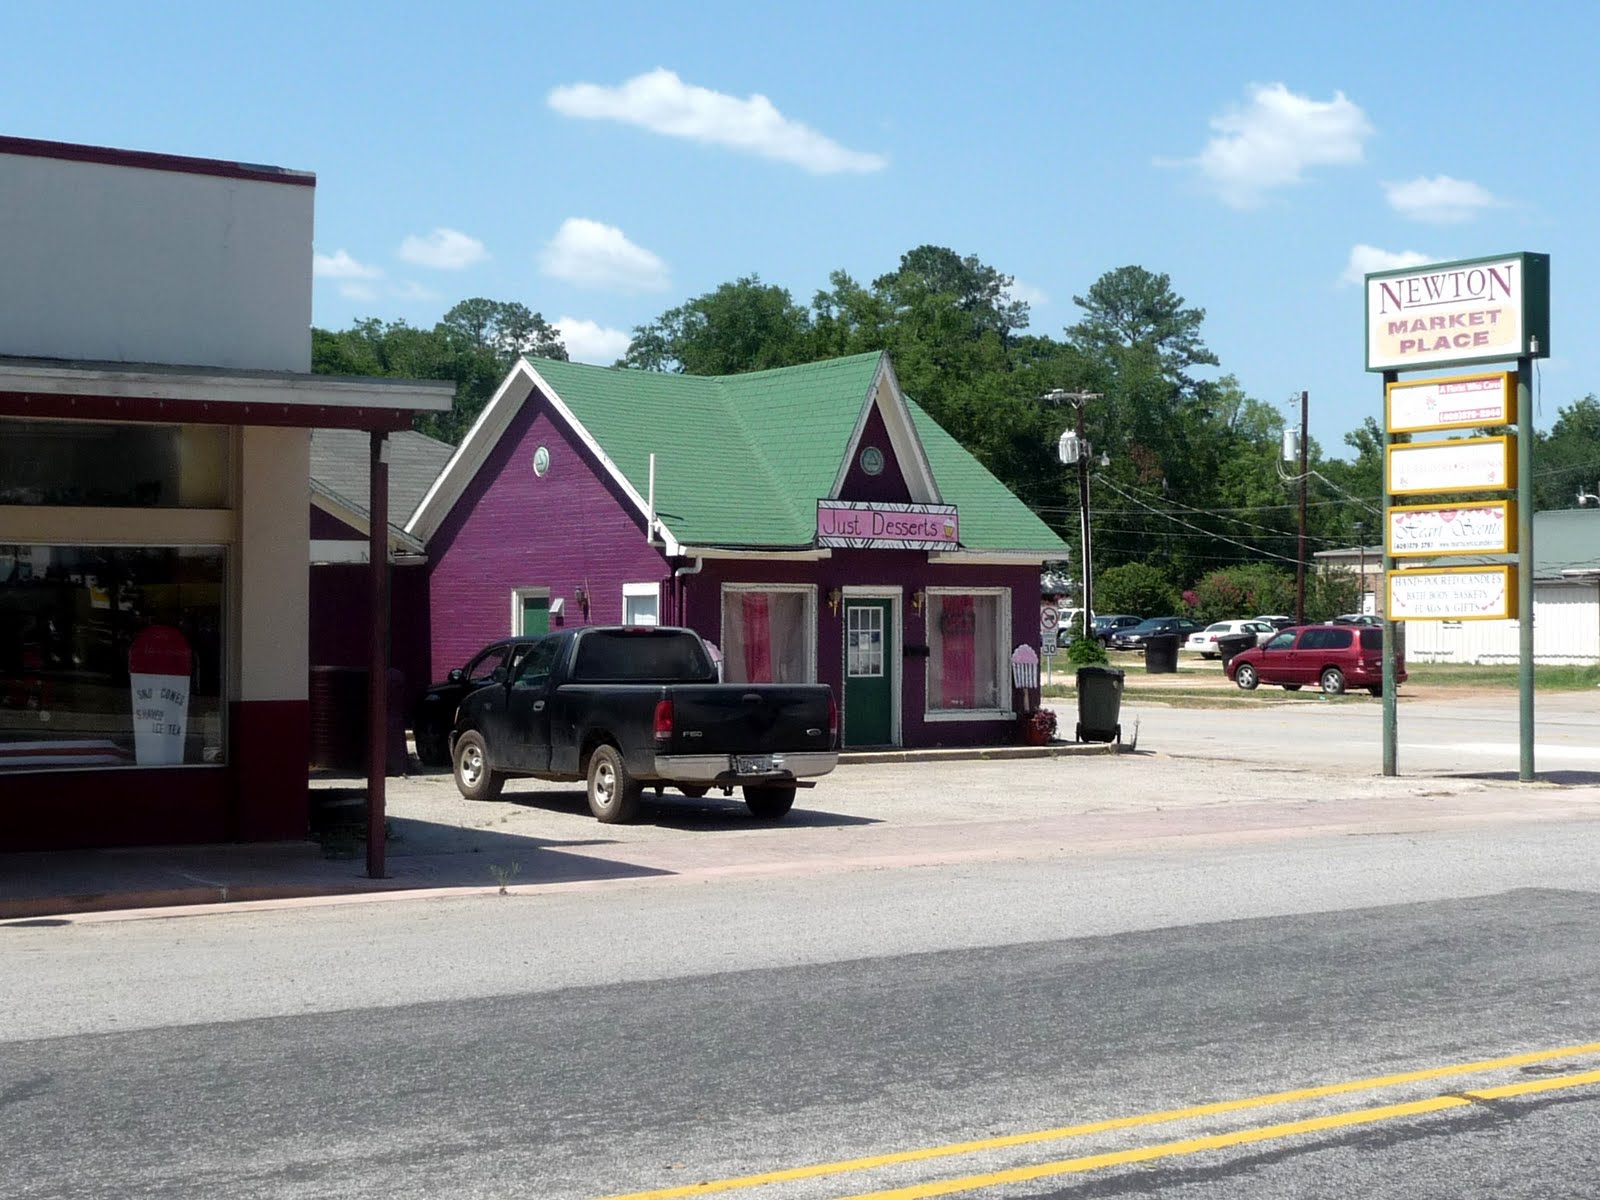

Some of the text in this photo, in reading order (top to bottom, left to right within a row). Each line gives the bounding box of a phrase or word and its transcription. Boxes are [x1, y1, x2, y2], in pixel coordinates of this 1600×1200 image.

[1379, 265, 1513, 314] NEWTON
[1388, 309, 1502, 335] MARKET
[1400, 331, 1489, 353] PLACE
[823, 509, 938, 537] Just Desserts
[1462, 574, 1502, 585] CANDLES
[1453, 602, 1480, 612] GIFTS
[1044, 644, 1056, 653] 30
[137, 688, 185, 706] SNO CONES
[152, 723, 181, 736] ICE TEA
